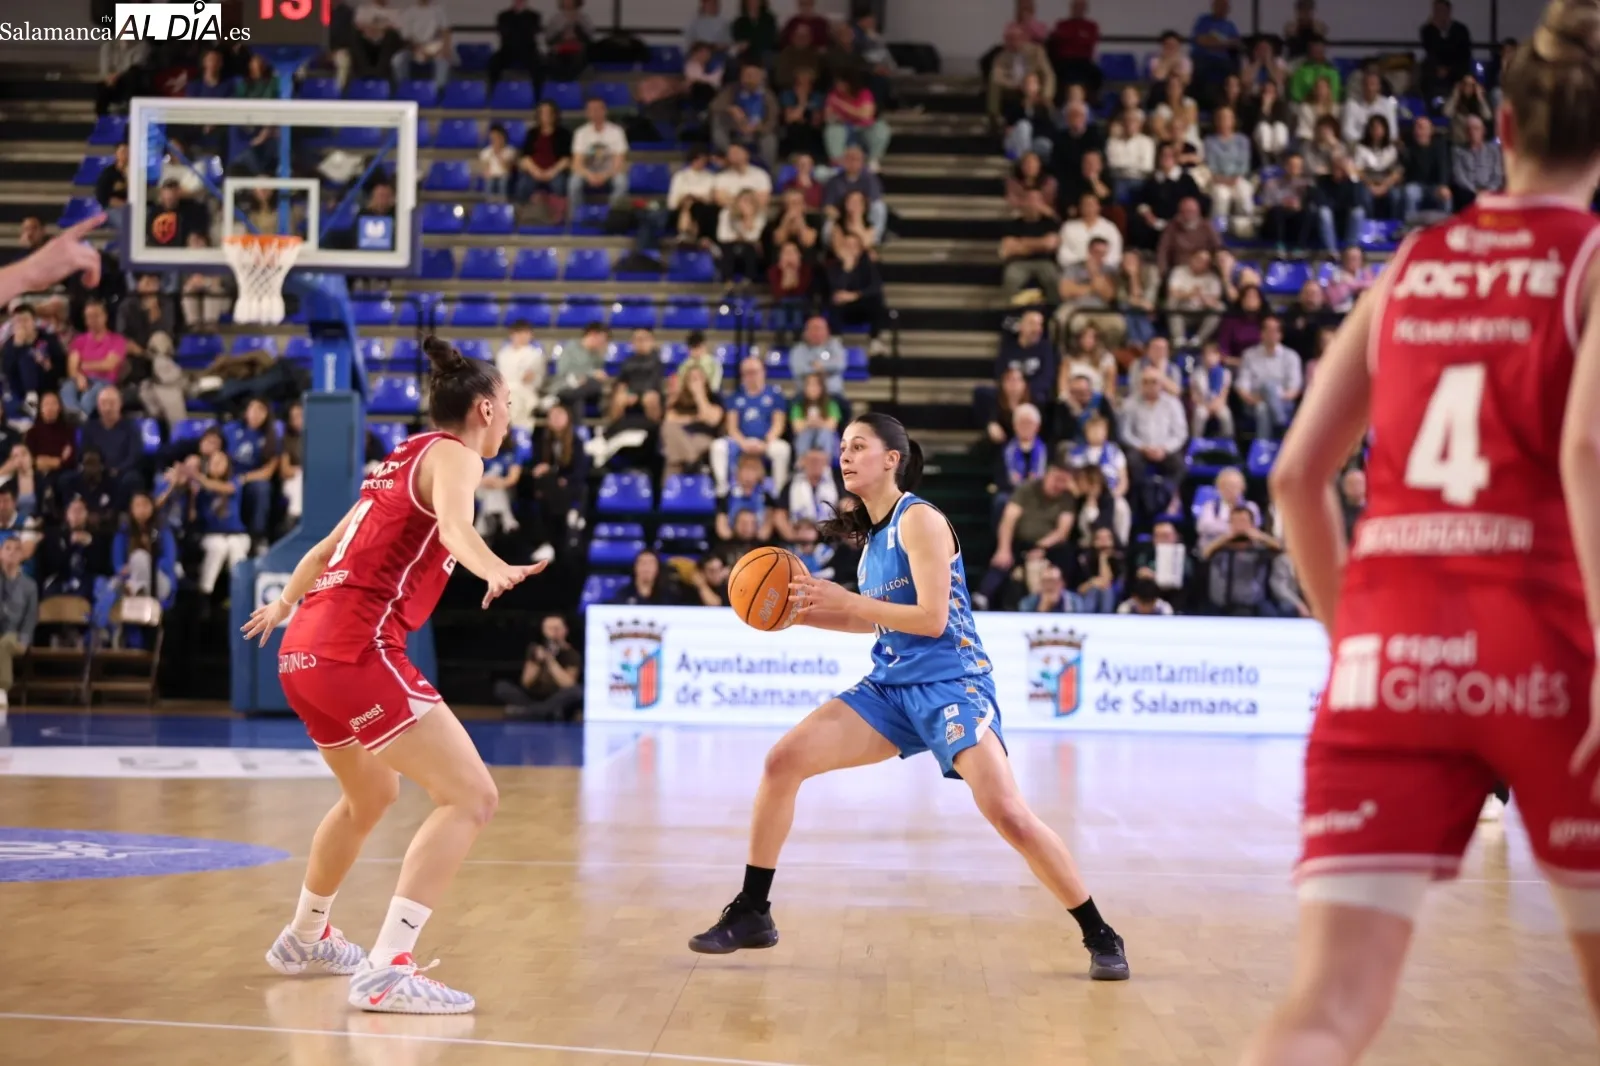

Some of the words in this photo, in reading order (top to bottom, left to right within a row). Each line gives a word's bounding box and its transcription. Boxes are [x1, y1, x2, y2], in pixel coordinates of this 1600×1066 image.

[1404, 361, 1491, 507] 4
[884, 576, 909, 592] LEÓN
[676, 650, 840, 678] Ayuntamiento
[1094, 659, 1260, 685] Ayuntamiento
[676, 683, 702, 705] de
[1095, 691, 1122, 713] de
[1132, 690, 1259, 716] Salamanca
